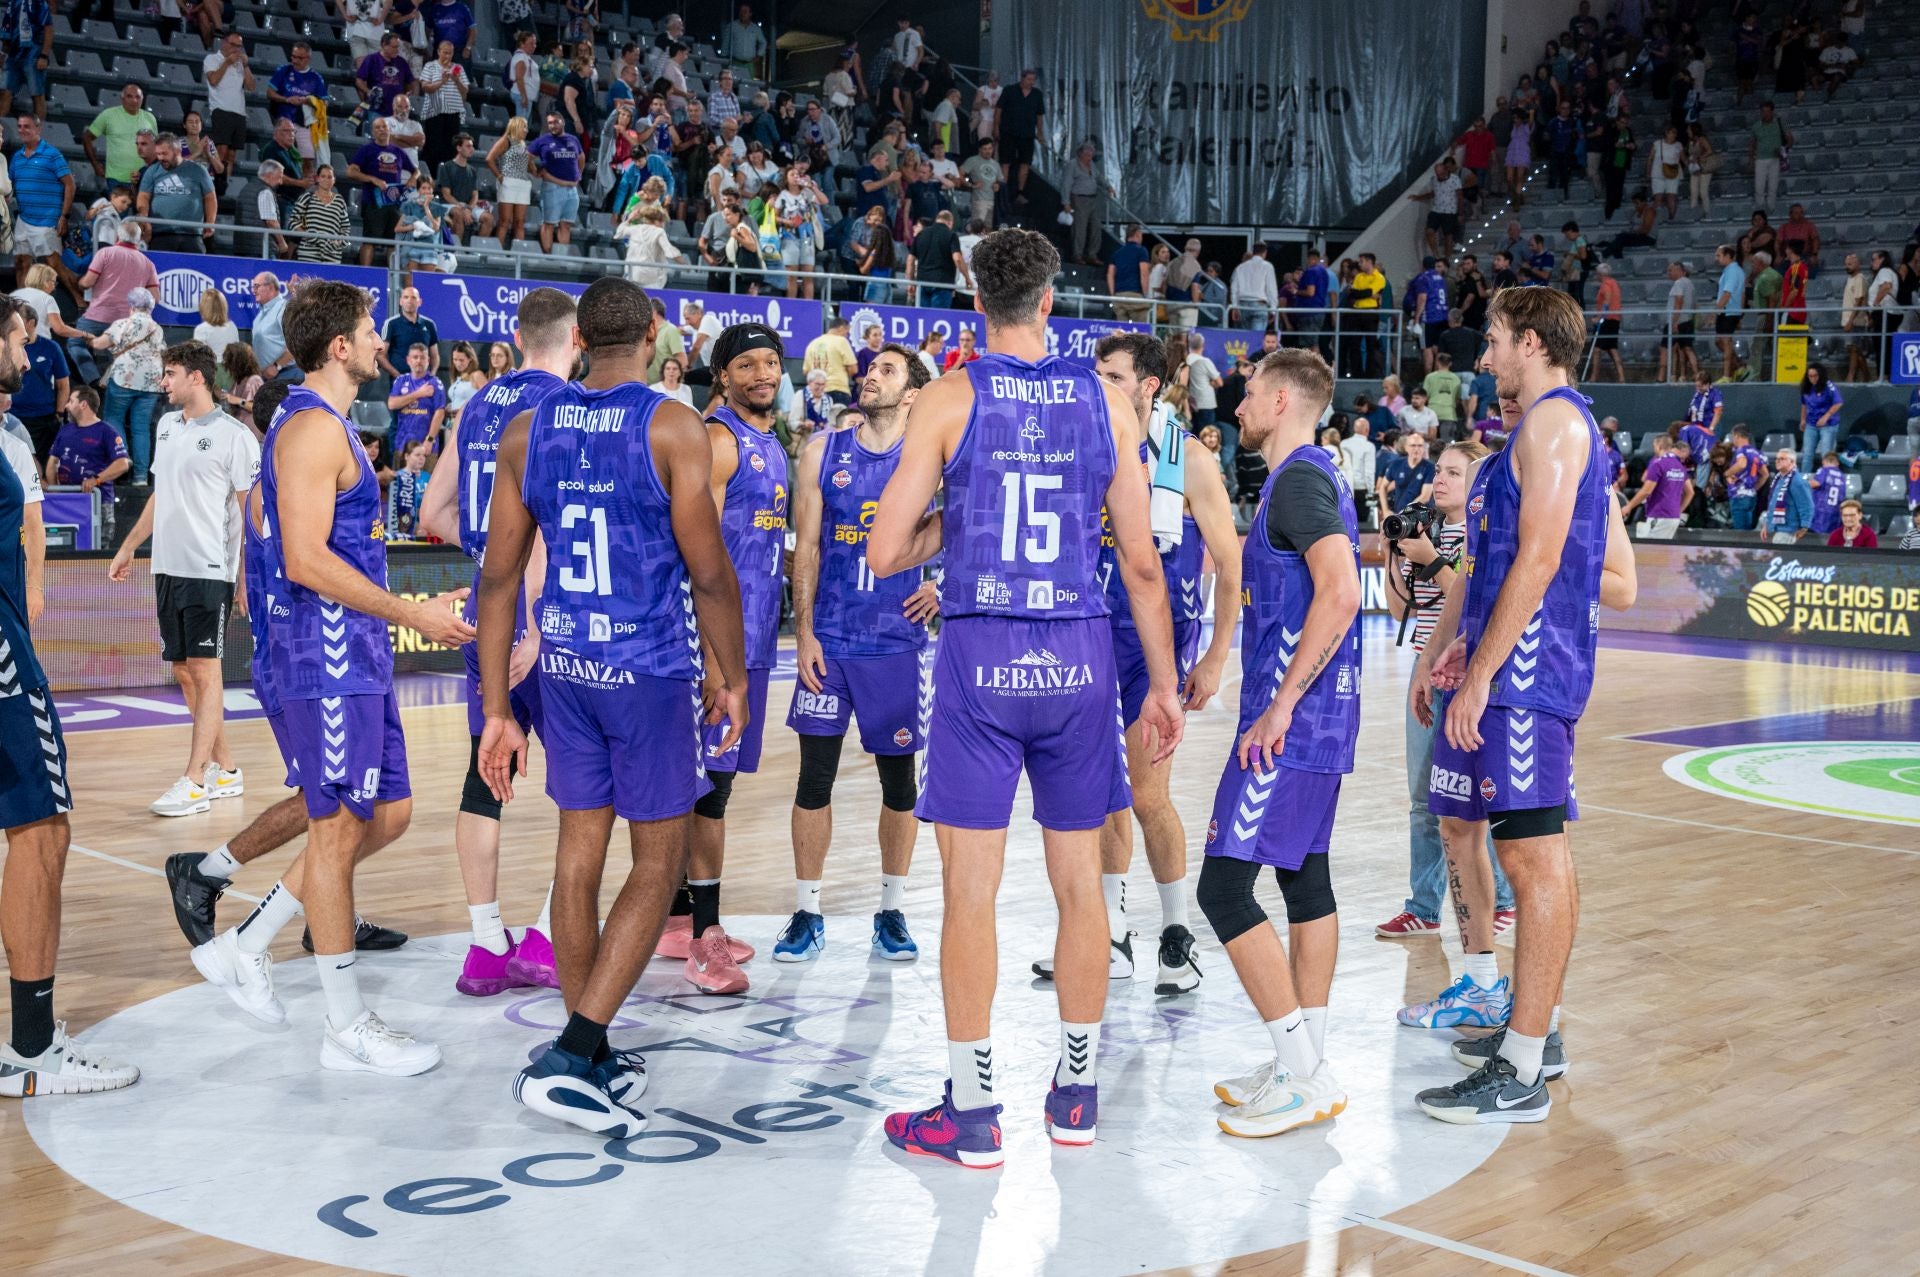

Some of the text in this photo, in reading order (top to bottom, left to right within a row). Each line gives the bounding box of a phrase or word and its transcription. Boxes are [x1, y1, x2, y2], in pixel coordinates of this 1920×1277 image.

[991, 376, 1077, 405] GONZALEZ
[1044, 449, 1075, 463] salud
[469, 461, 497, 532] 17
[1001, 472, 1063, 563] 15
[559, 503, 612, 596] 31
[1765, 556, 1836, 583] Estamos
[996, 590, 1012, 598] LEN
[997, 582, 1008, 590] PA
[995, 597, 1010, 605] CIA
[1056, 590, 1078, 604] Dip
[1794, 582, 1920, 612] HECHOS DE
[272, 604, 290, 617] Dip
[562, 613, 571, 621] PA
[561, 621, 576, 629] LEN
[614, 622, 637, 635] Dip
[1793, 606, 1911, 637] PALENCIA
[560, 627, 572, 636] CIA
[541, 653, 636, 684] LEBANZA
[976, 664, 1094, 689] LEBANZA
[1018, 689, 1047, 697] MINERAL
[1048, 687, 1077, 696] NATURAL
[797, 690, 839, 715] gaza
[1430, 765, 1472, 796] gaza
